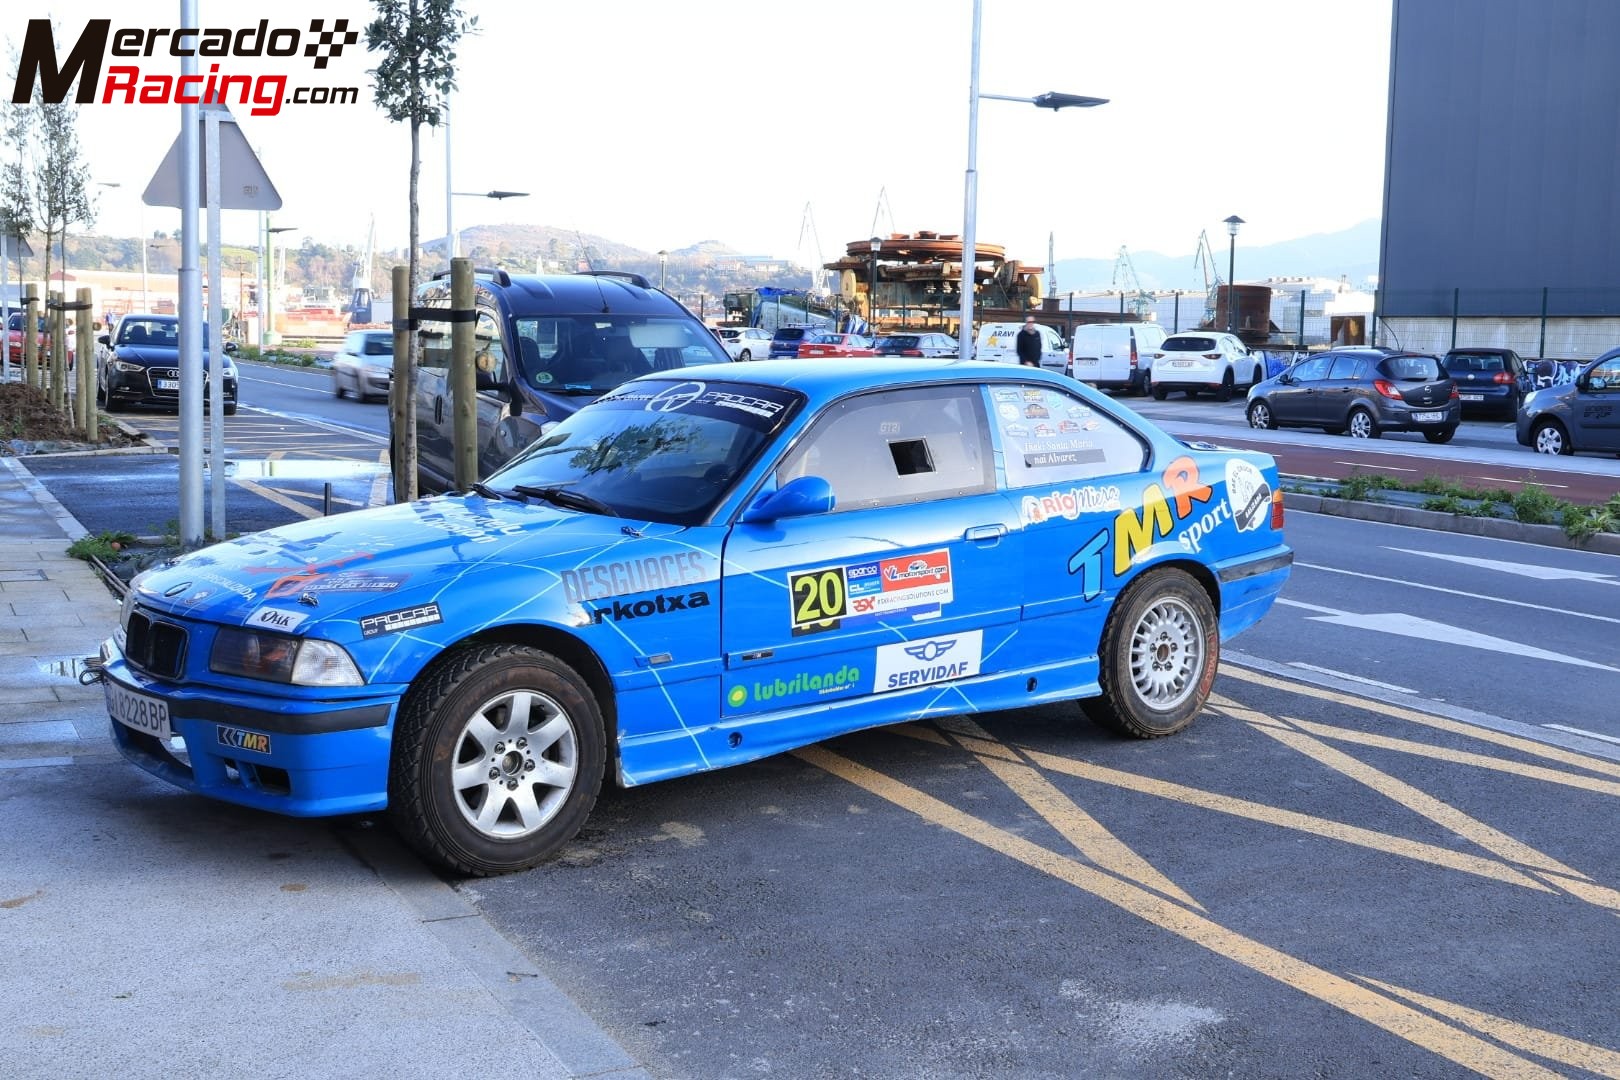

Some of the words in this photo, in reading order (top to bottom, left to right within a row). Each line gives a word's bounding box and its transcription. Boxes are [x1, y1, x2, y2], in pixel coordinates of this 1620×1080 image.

[703, 391, 784, 413] PROCAR
[1068, 455, 1213, 602] TMR
[1178, 498, 1231, 553] sport
[560, 552, 707, 604] DESGUACES
[795, 571, 843, 622] 20
[361, 605, 439, 629] PROCAR
[887, 661, 968, 689] SERVIDAF
[236, 729, 268, 753] TMR
